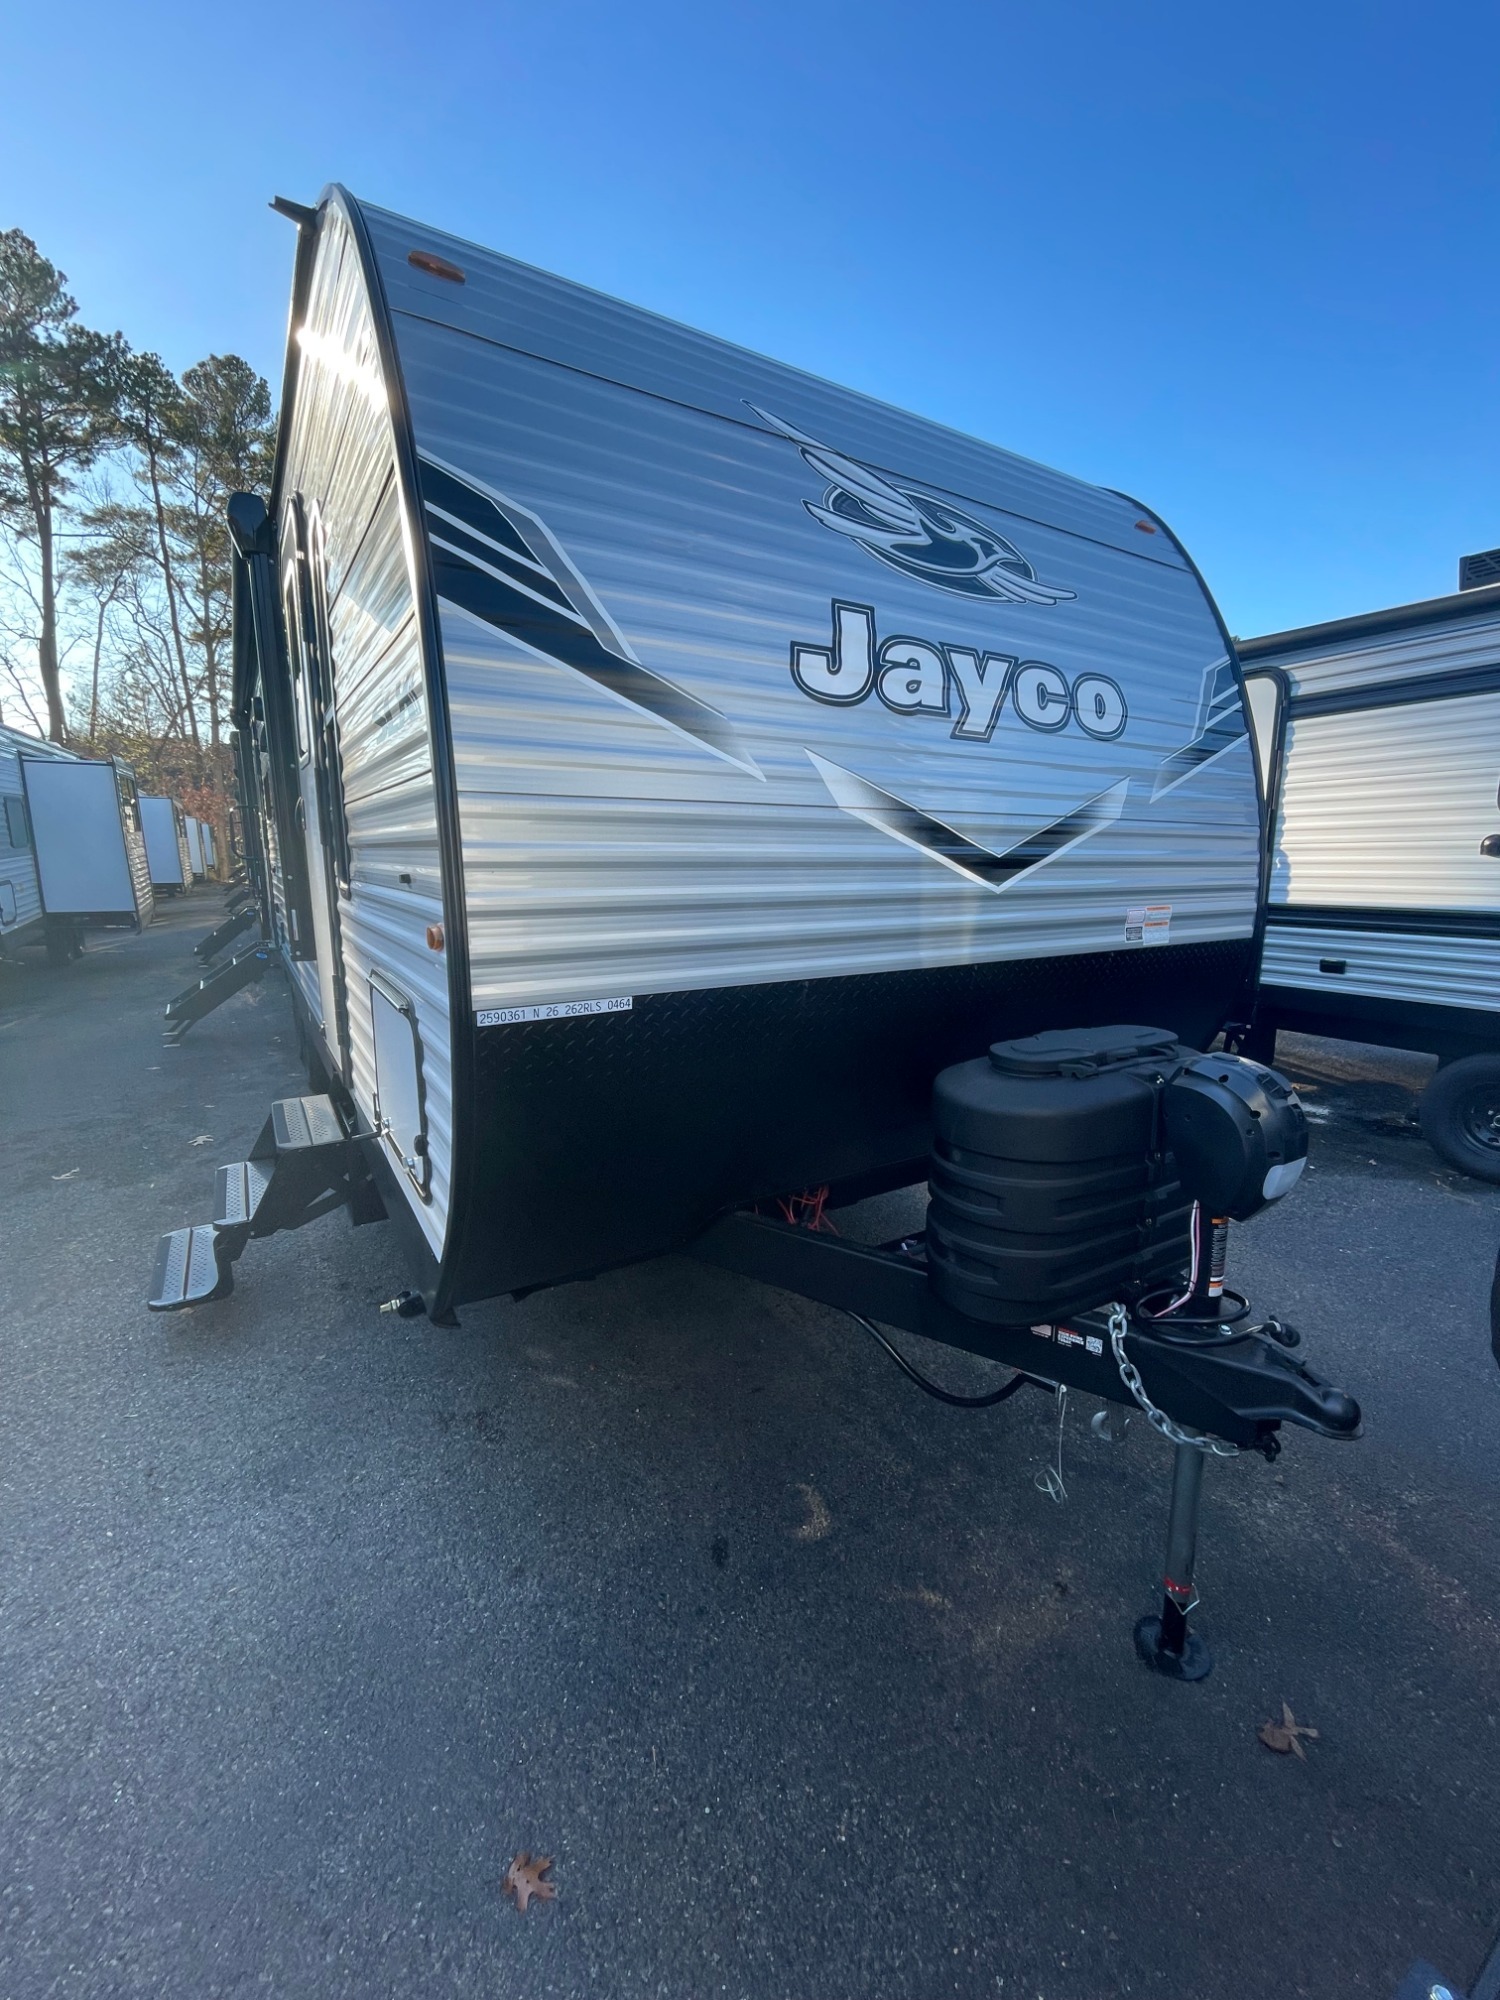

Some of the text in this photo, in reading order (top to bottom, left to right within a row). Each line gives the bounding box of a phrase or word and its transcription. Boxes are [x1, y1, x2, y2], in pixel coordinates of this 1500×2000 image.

[790, 598, 1128, 743] Jayco
[479, 998, 631, 1025] 2590361 N 26 262RLS 0464
